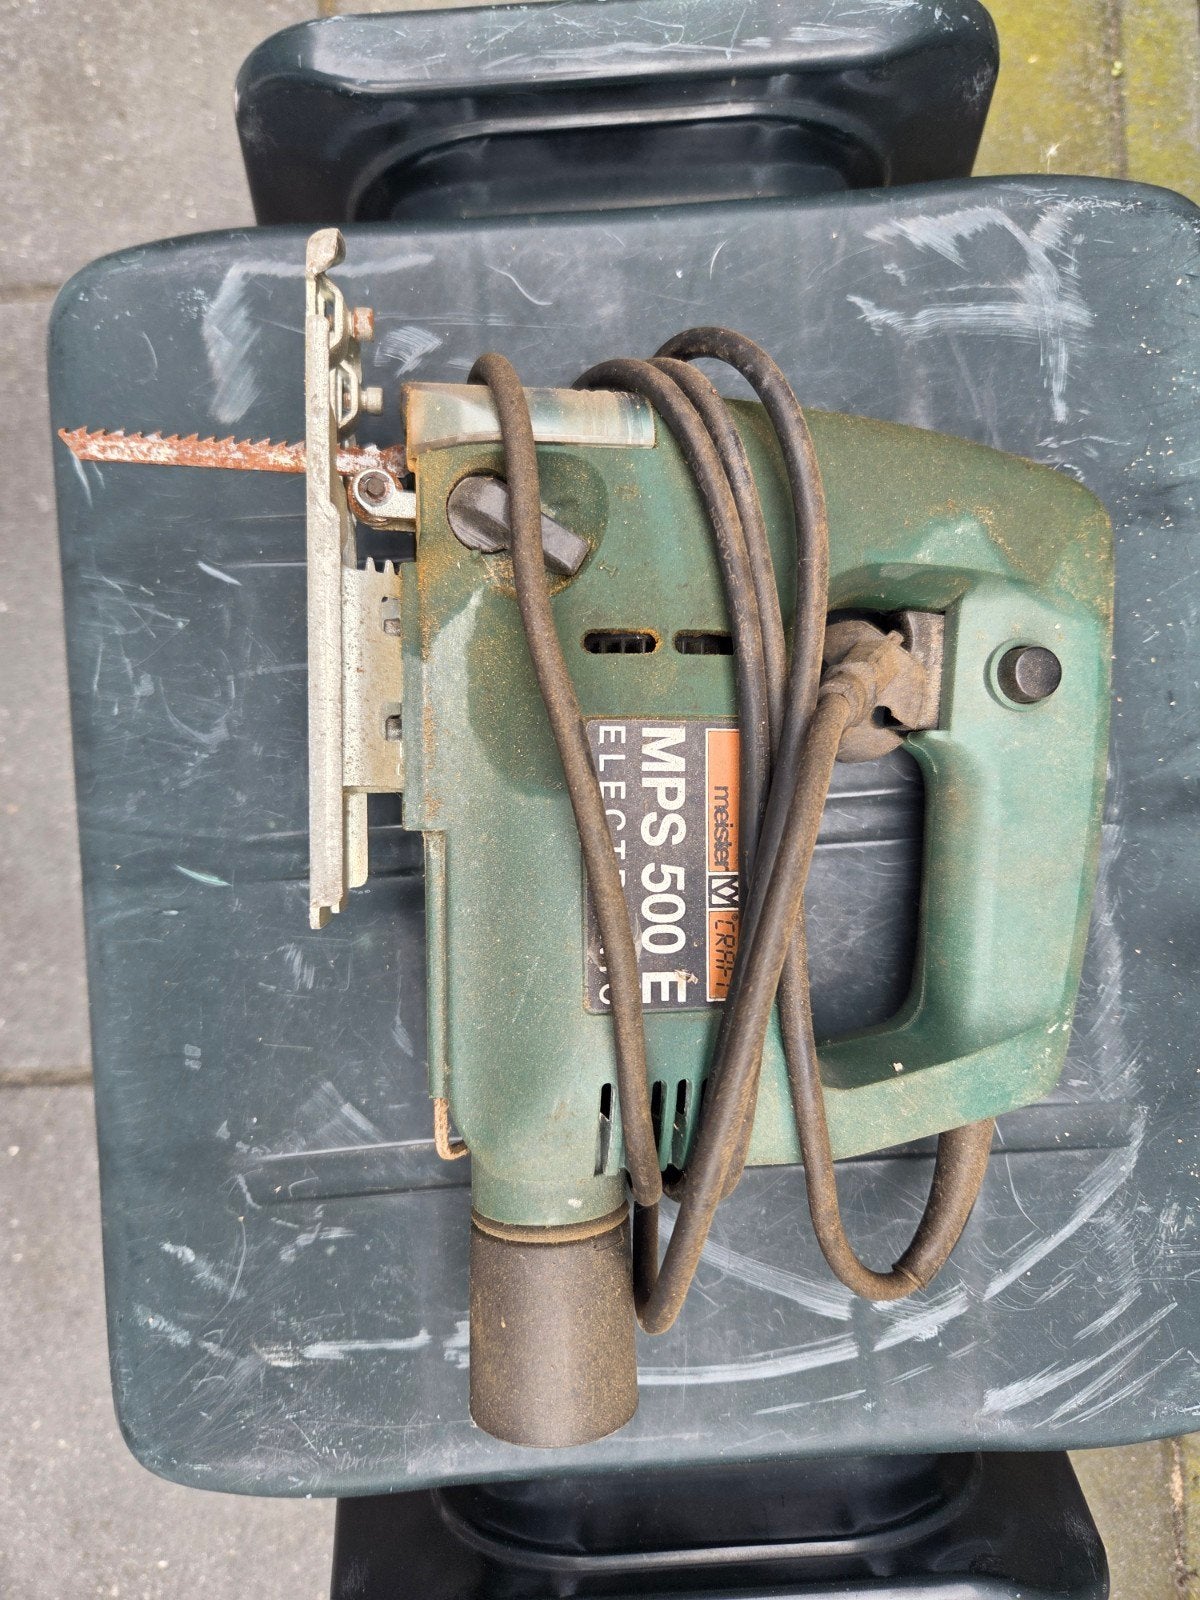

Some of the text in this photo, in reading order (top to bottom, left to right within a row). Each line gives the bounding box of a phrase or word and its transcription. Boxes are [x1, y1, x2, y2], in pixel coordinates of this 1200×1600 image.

[598, 725, 627, 1005] ELECT
[640, 726, 687, 1004] MPS 500 E
[713, 785, 734, 872] meister
